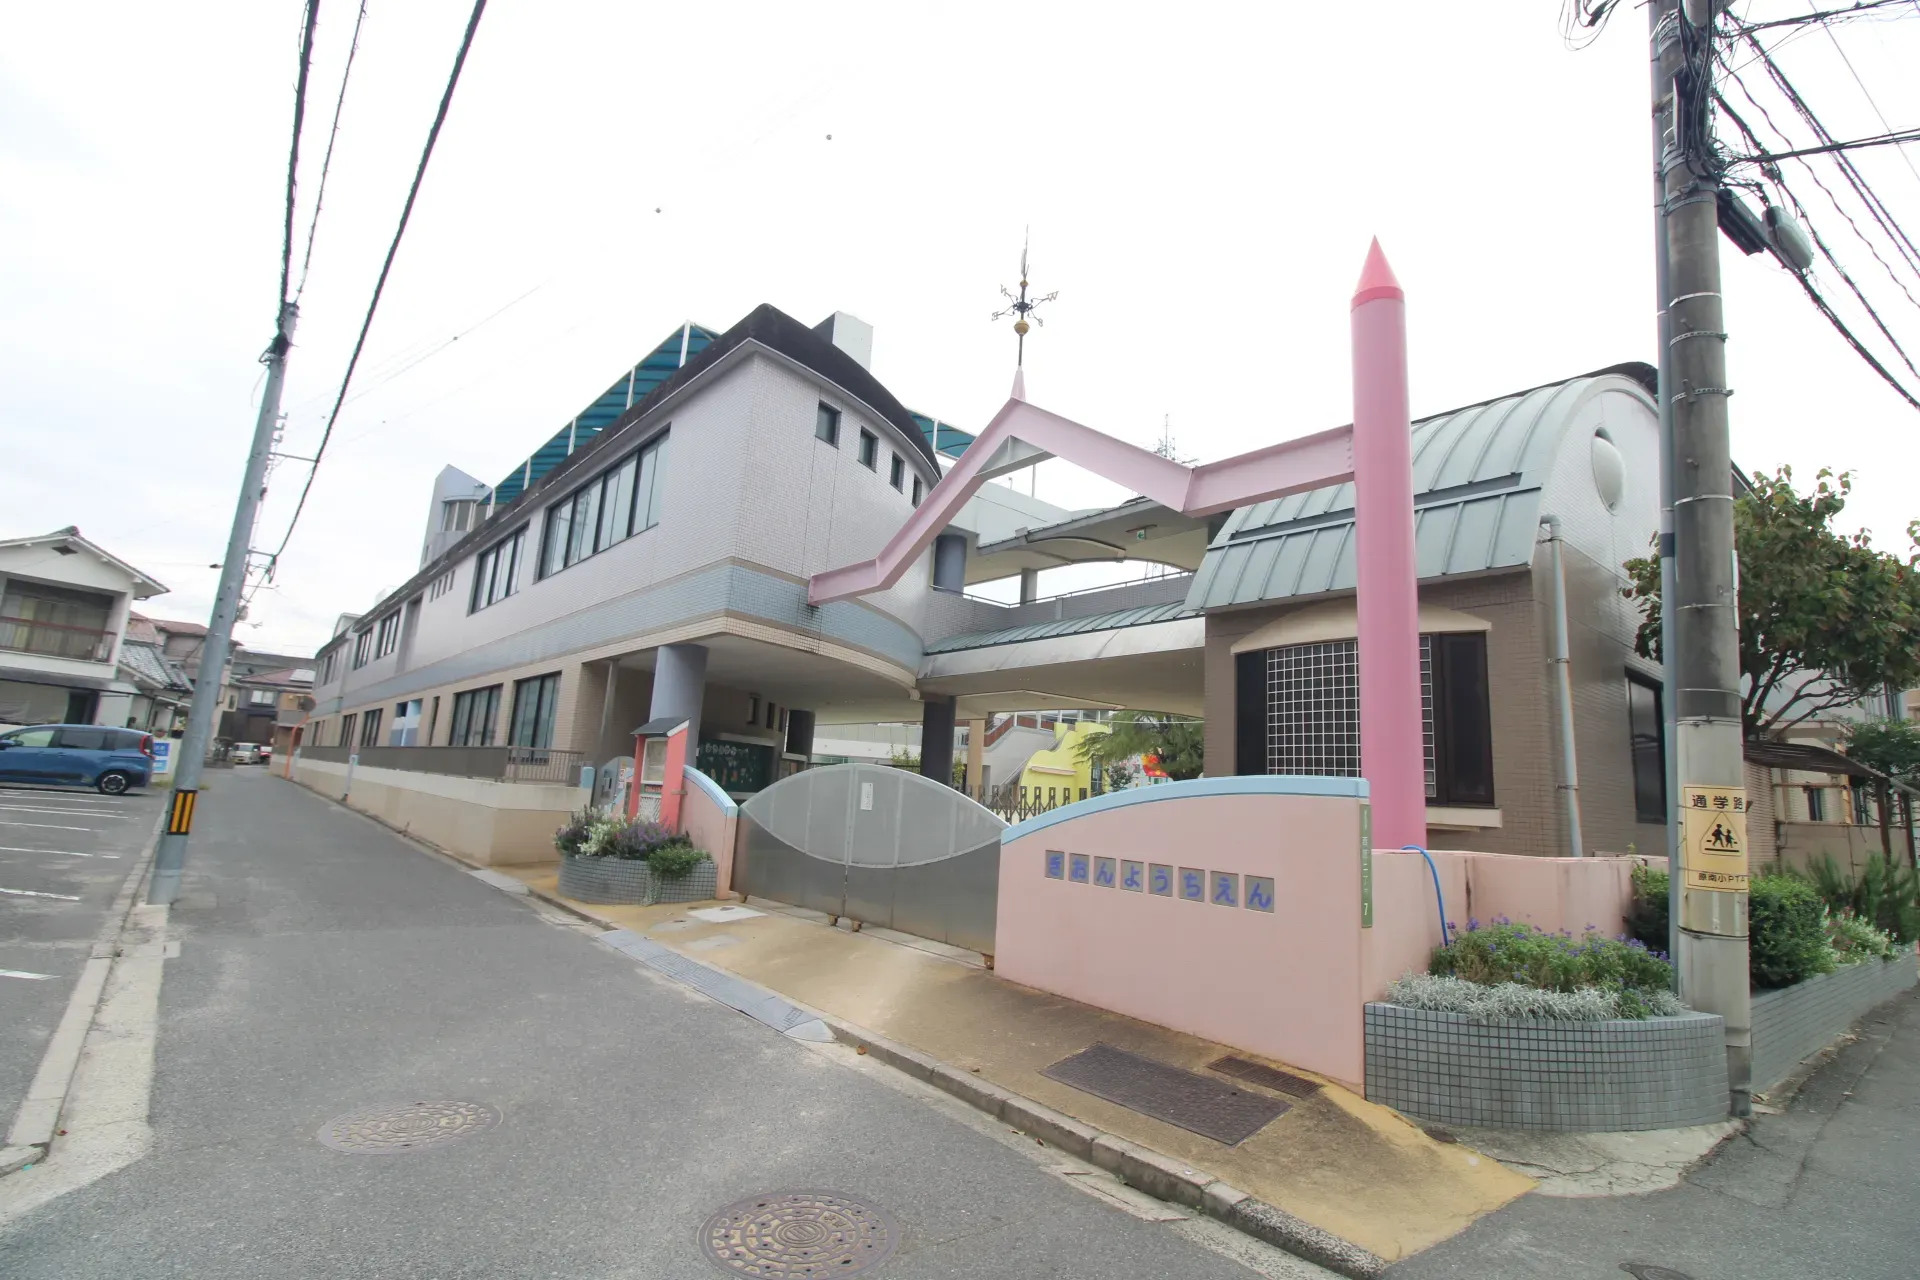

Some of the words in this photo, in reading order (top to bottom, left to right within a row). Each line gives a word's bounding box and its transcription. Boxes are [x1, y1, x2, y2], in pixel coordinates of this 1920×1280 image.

[1692, 795, 1743, 810] 通学路
[1049, 855, 1272, 909] ぎおんようちえん
